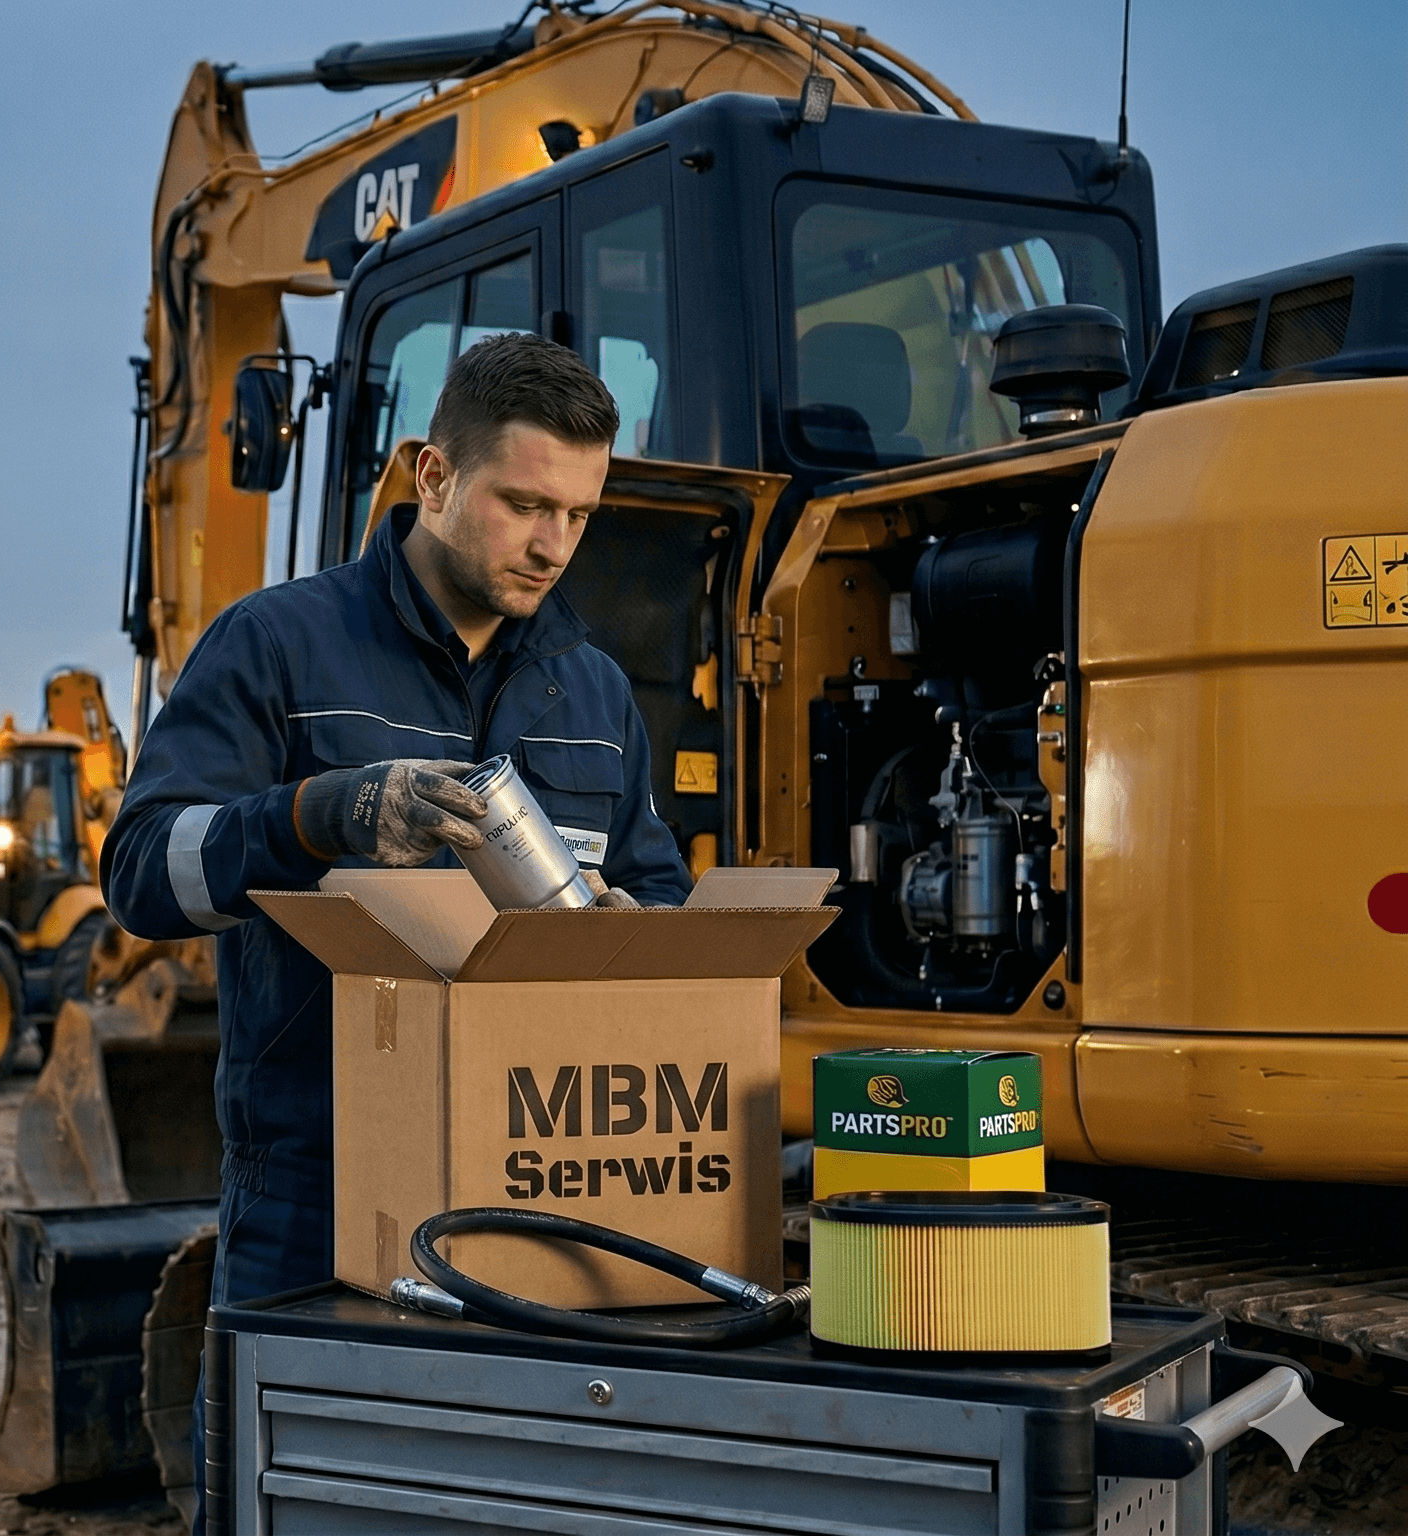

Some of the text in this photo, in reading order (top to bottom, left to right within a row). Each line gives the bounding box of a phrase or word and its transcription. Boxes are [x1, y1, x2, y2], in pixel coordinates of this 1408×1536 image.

[354, 163, 420, 243] CAT
[508, 1062, 728, 1138] MBM
[505, 1141, 731, 1199] Serwis
